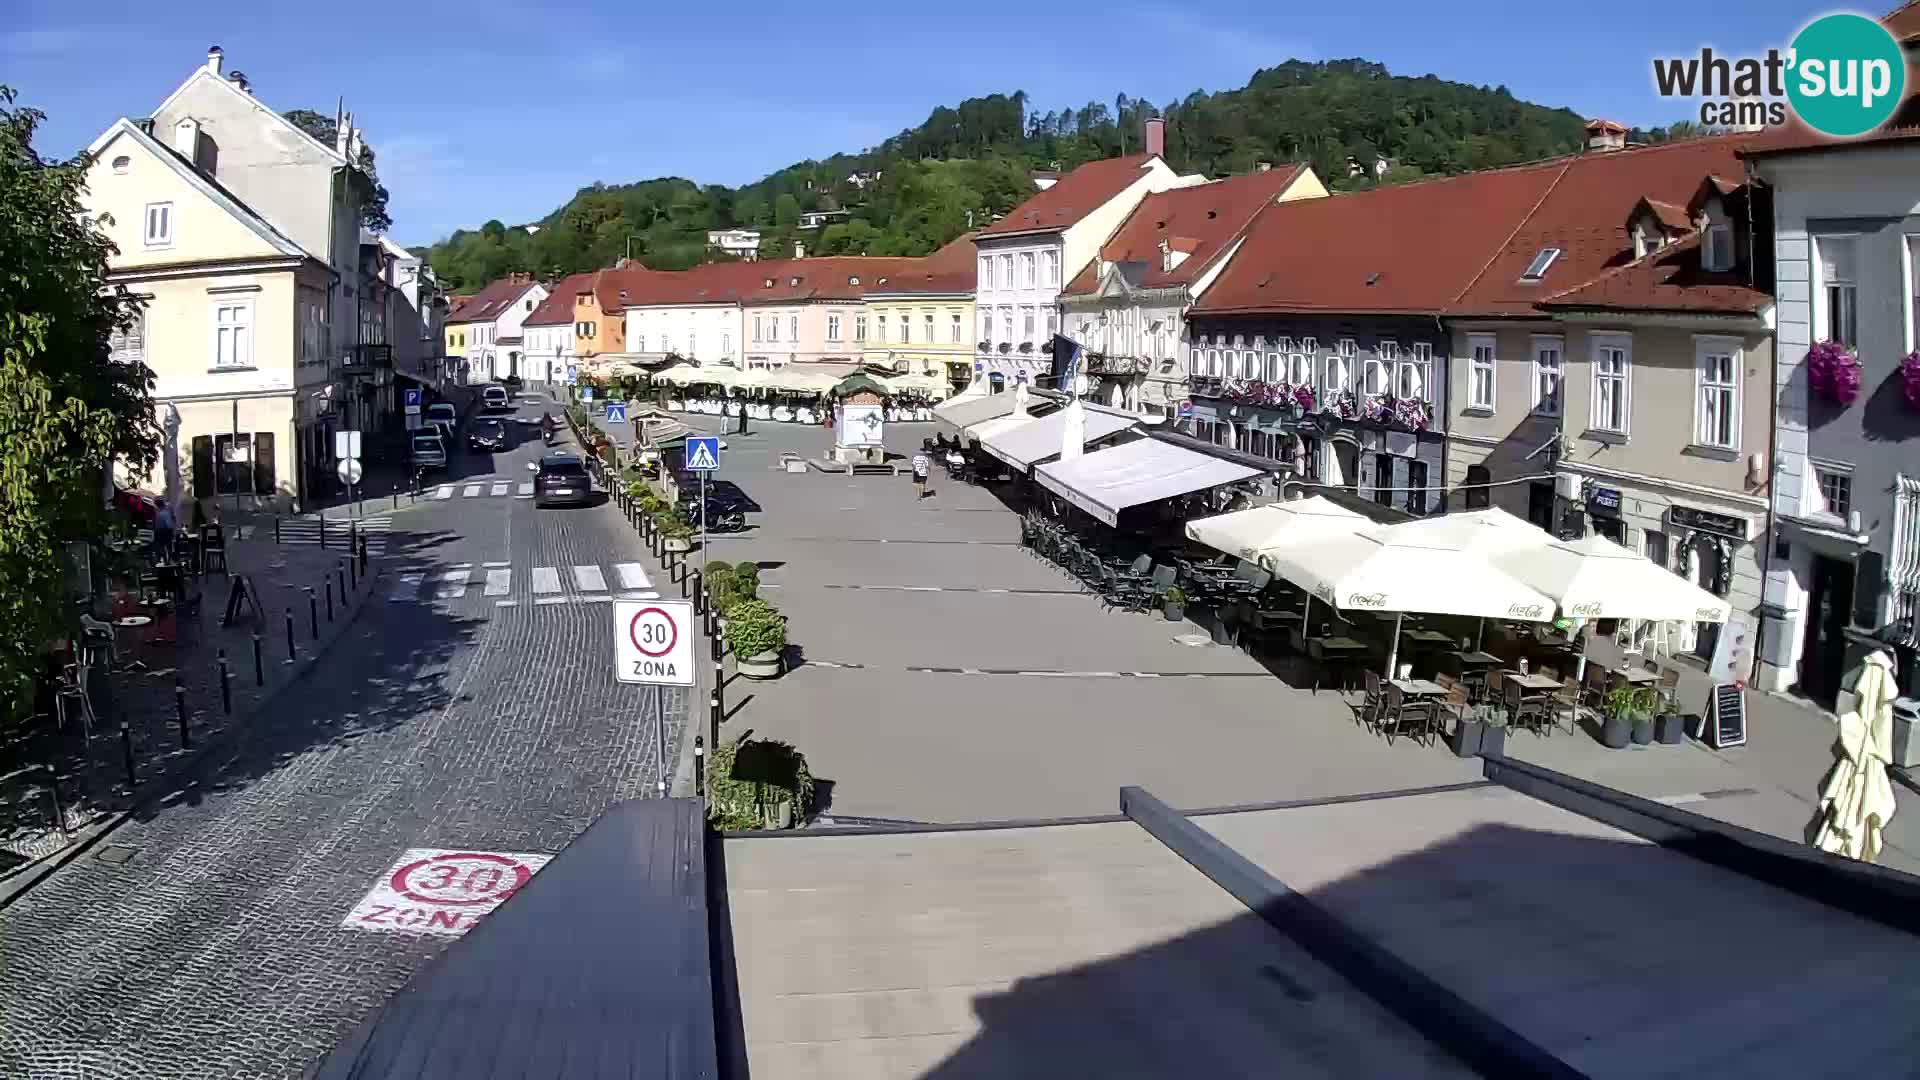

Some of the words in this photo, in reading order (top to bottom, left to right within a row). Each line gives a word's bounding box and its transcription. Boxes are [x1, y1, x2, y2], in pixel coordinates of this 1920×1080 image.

[642, 623, 667, 644] 30
[632, 660, 677, 676] ZONA
[419, 865, 503, 894] 30
